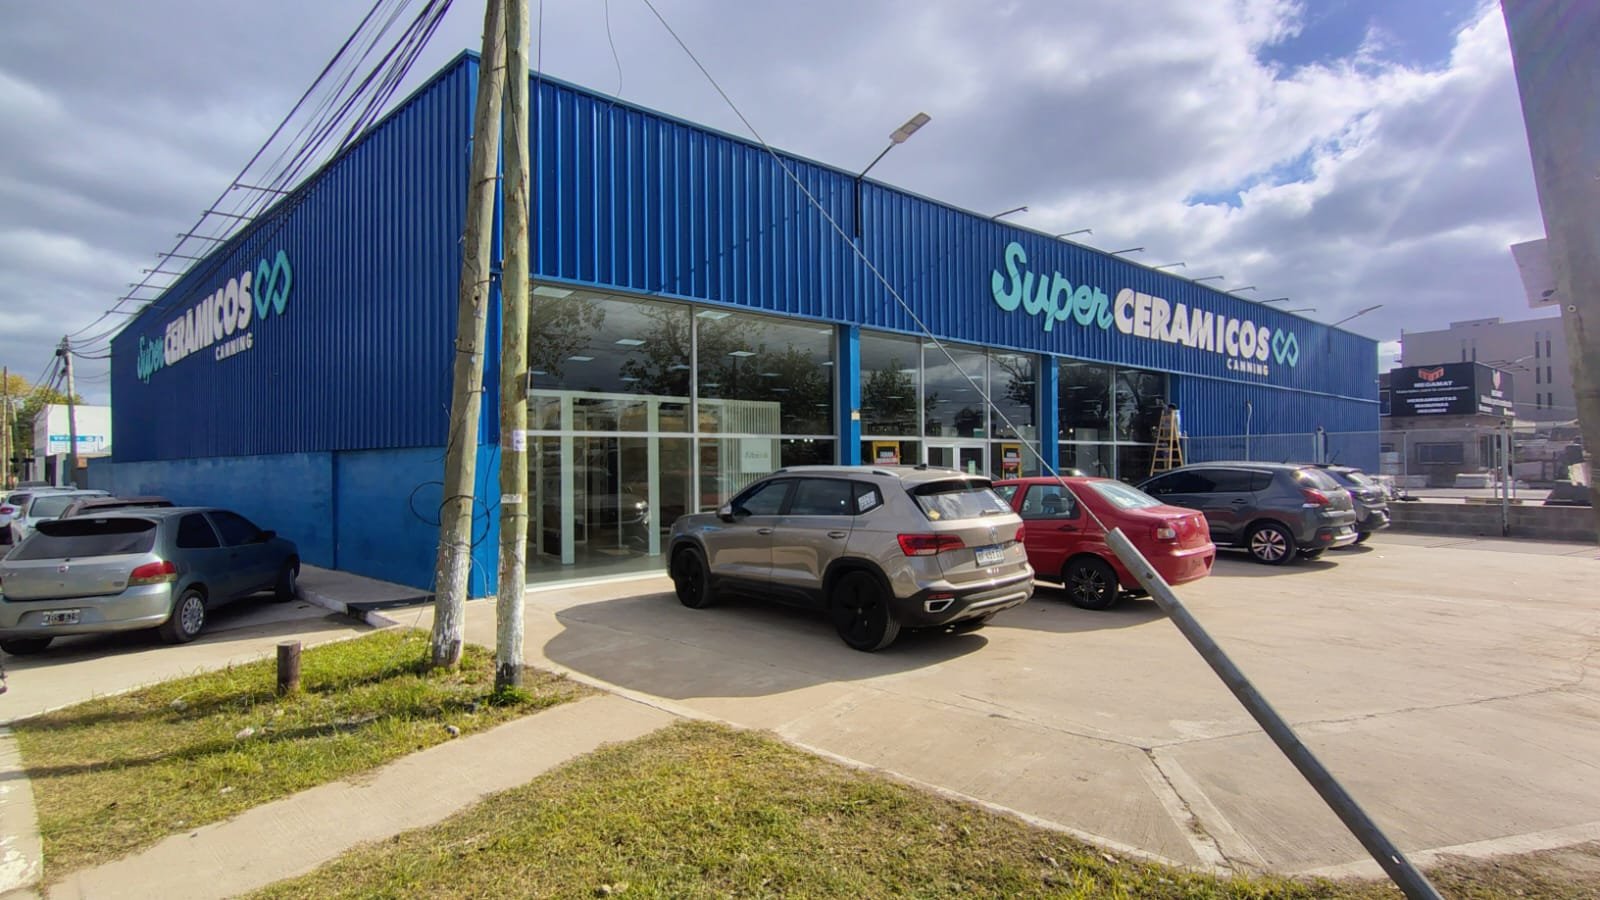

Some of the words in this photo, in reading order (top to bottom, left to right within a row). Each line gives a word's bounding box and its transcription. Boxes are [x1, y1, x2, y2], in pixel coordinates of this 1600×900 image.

[992, 241, 1114, 332] Super
[1114, 287, 1270, 361] CERAMICOS
[215, 332, 254, 361] CANNING
[1226, 358, 1270, 376] CANNING
